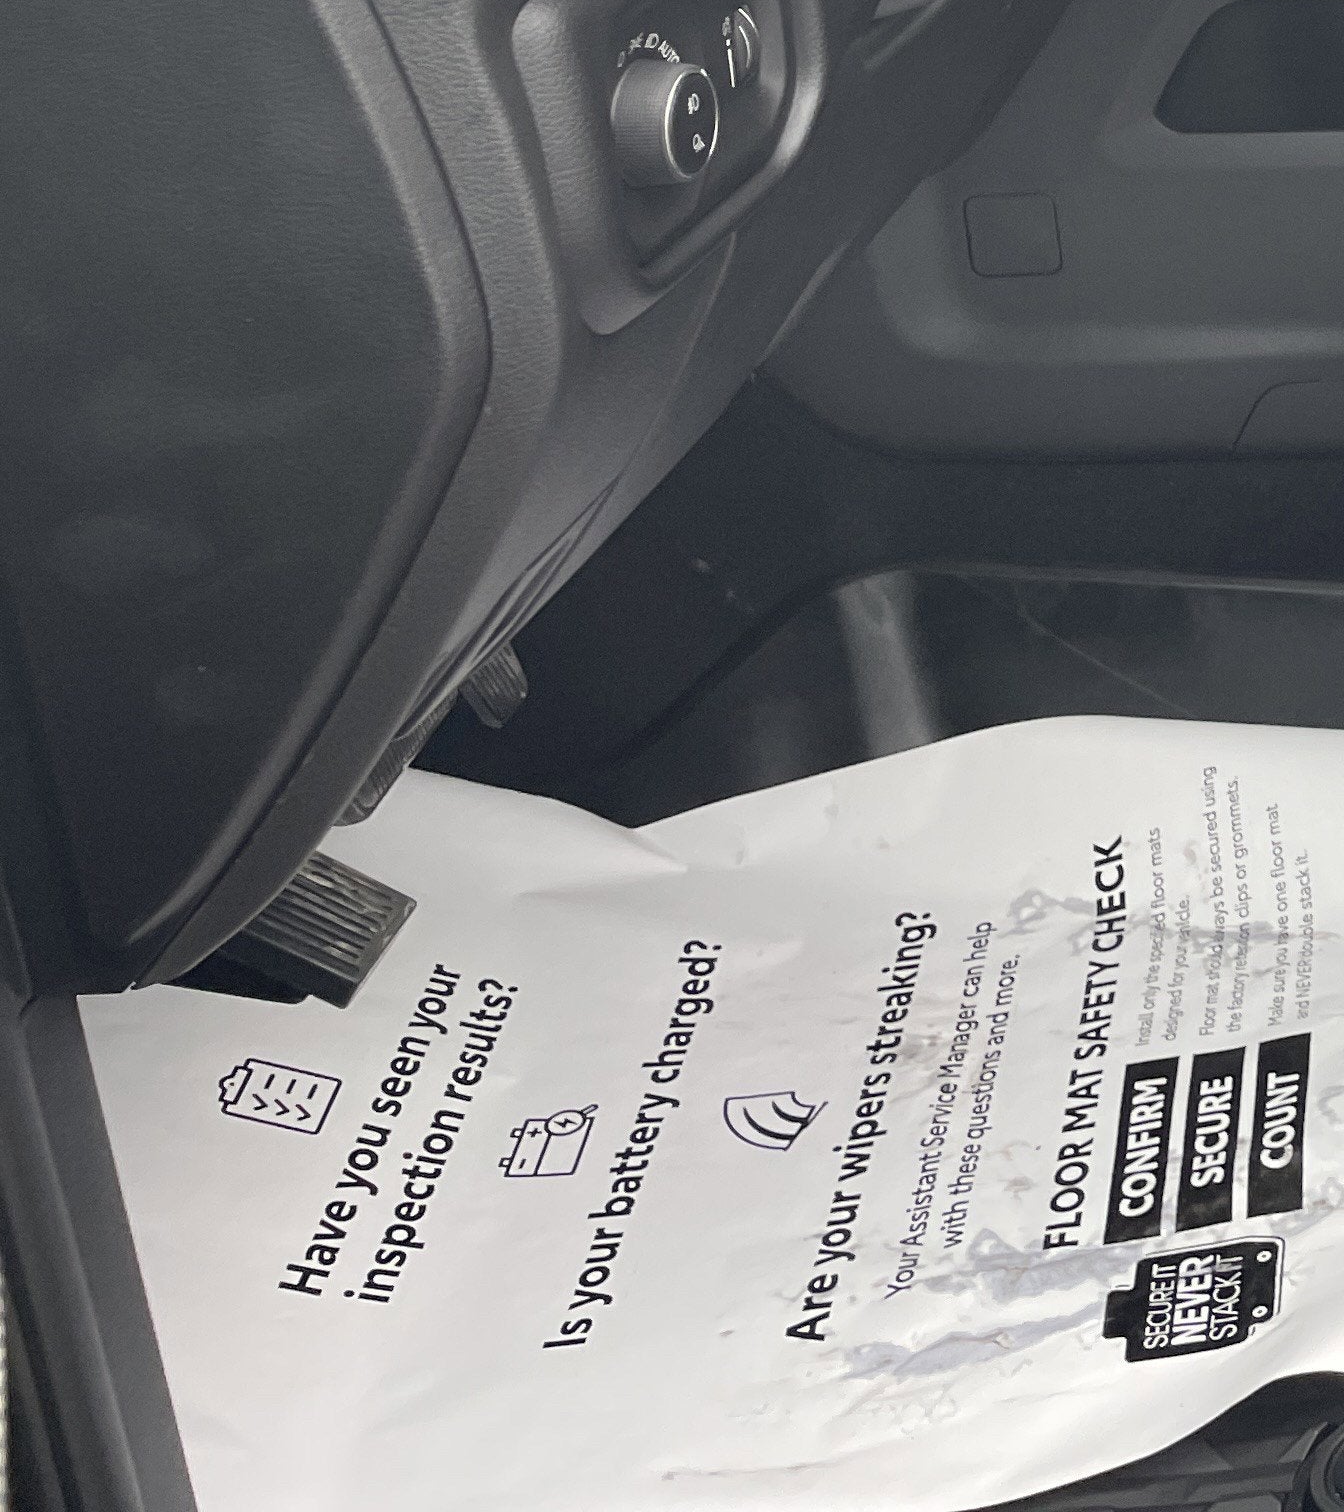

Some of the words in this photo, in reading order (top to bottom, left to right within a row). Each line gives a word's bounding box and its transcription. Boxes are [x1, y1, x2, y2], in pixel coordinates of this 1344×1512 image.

[658, 40, 680, 63] AUTO
[1200, 766, 1217, 807] using
[1226, 776, 1248, 858] grommets.
[1266, 804, 1281, 835] mat
[1147, 828, 1162, 866] mats
[1202, 811, 1222, 873] secured
[1269, 841, 1285, 878] floor
[1294, 849, 1309, 867] it.
[1151, 872, 1166, 908] floor
[1210, 876, 1224, 898] be
[1232, 864, 1246, 879] or
[1294, 870, 1311, 909] stack
[1092, 834, 1127, 954] CHECK
[1233, 884, 1251, 918] clips
[1273, 882, 1288, 912] one
[968, 921, 997, 956] help
[1171, 944, 1189, 970] your
[1273, 948, 1290, 968] you
[1294, 914, 1313, 958] double
[866, 911, 937, 1065] streaking?
[963, 959, 982, 997] can
[998, 952, 1020, 1007] more.
[1144, 965, 1160, 983] the
[1168, 972, 1183, 987] for
[1205, 982, 1218, 1004] mat
[1230, 972, 1248, 1010] factory
[1271, 969, 1286, 992] sure
[1296, 960, 1310, 998] NEVER
[641, 939, 722, 1083] charged?
[1074, 960, 1120, 1061] SAFETY
[1143, 986, 1160, 1010] only
[1162, 990, 1182, 1041] designed
[1268, 996, 1284, 1027] Make
[1296, 1000, 1309, 1018] and
[937, 1003, 979, 1078] Manager
[985, 1012, 1009, 1056] and
[1135, 1014, 1154, 1047] Install
[1200, 1007, 1217, 1036] Floor
[1227, 1012, 1242, 1032] the
[921, 1080, 958, 1147] Service
[964, 1058, 1001, 1140] questions
[1062, 1069, 1103, 1134] MAT
[1260, 1071, 1300, 1170] COUNT
[278, 1199, 358, 1296] Have
[335, 1122, 392, 1196] you
[371, 1036, 430, 1117] seen
[408, 964, 461, 1034] your
[343, 1109, 465, 1303] inspection
[444, 978, 518, 1101] results?
[832, 1073, 891, 1183] wipers
[1119, 1074, 1168, 1218] CONFIRM
[1190, 1074, 1234, 1187] SECURE
[587, 1093, 680, 1219] battery
[951, 1143, 979, 1195] these
[899, 1148, 943, 1246] Assistant
[1043, 1137, 1093, 1250] FLOOR
[813, 1190, 862, 1268] your
[941, 1201, 969, 1250] with
[568, 1227, 624, 1310] your
[884, 1248, 921, 1300] Your
[785, 1273, 839, 1342] Are
[1143, 1282, 1175, 1350] SECURE
[1170, 1254, 1215, 1346] NEVER
[1209, 1271, 1242, 1341] STACK
[542, 1317, 593, 1349] Is
